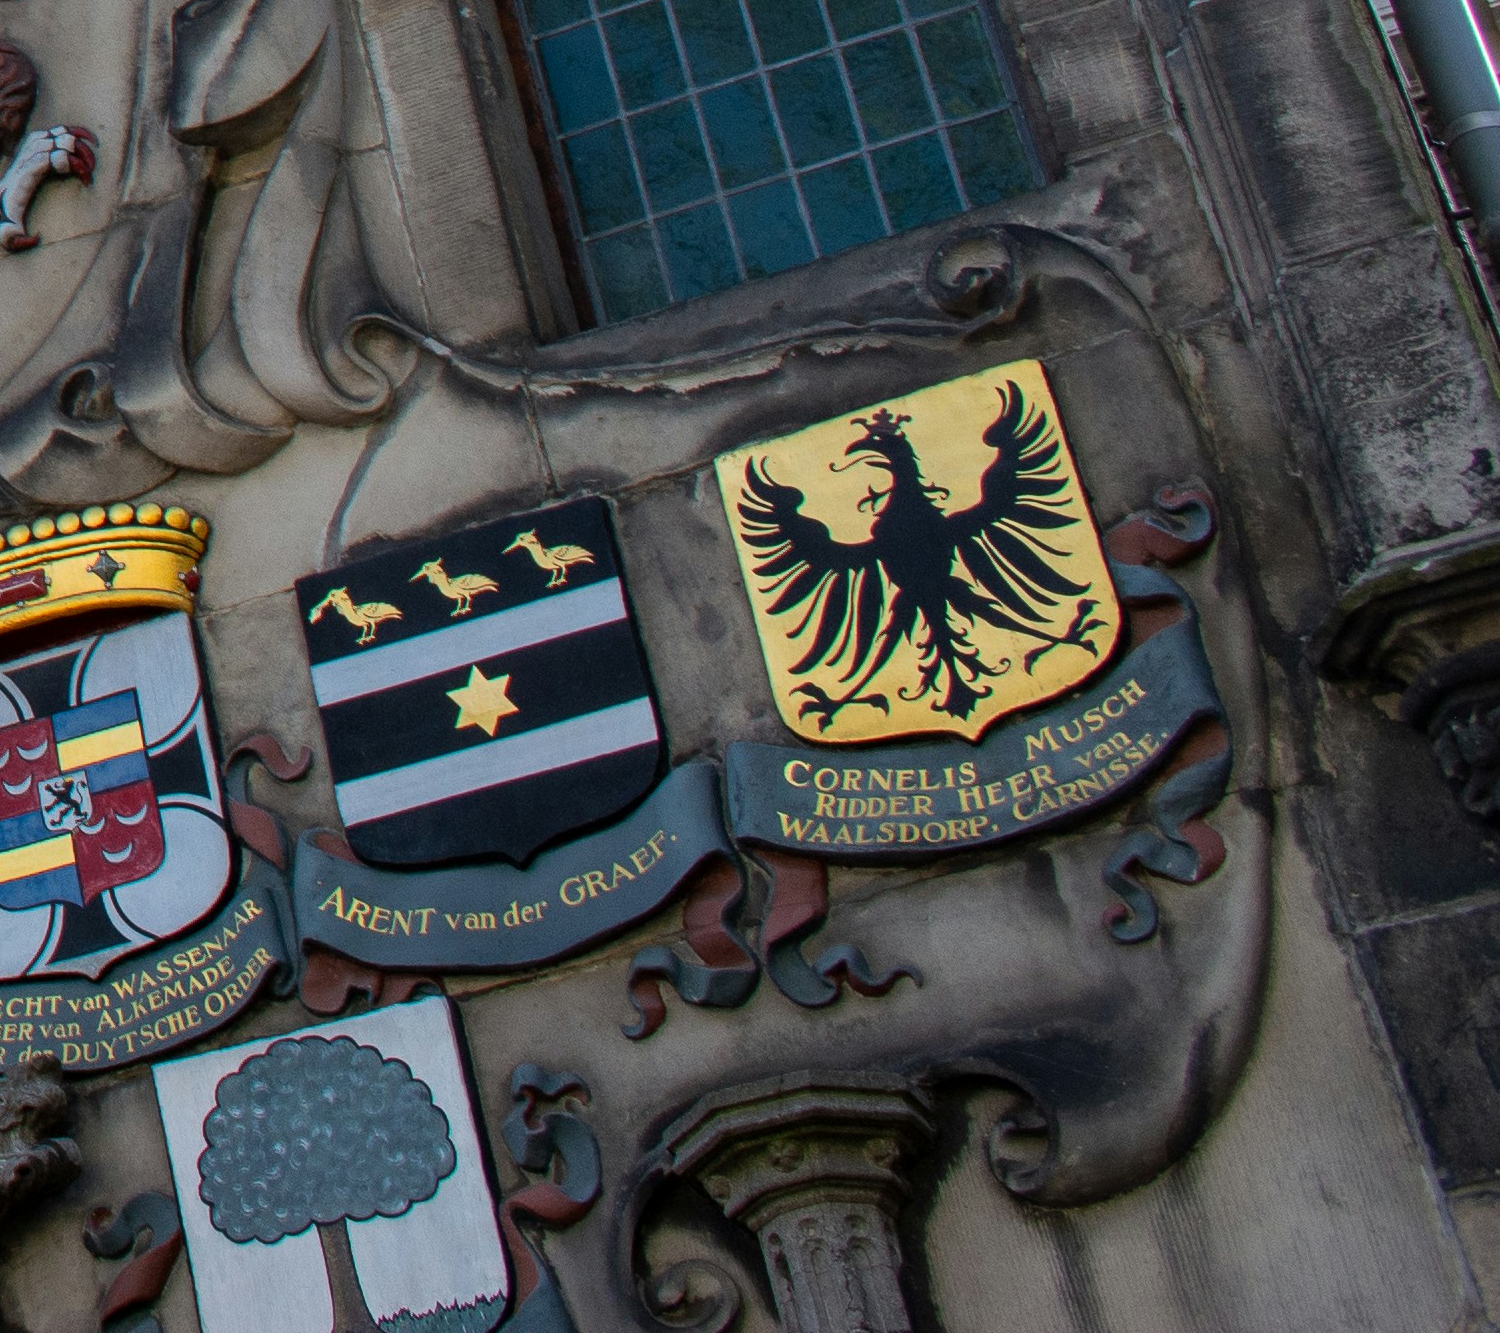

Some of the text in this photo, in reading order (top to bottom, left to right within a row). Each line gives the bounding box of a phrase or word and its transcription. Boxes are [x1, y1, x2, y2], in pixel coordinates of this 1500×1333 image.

[777, 730, 1170, 846] WAALSDORP, CARNISSE.
[783, 679, 1147, 793] CORNELIS MUSCH
[814, 732, 1133, 819] RIDDER HEER van
[318, 830, 678, 937] ARENT van der GRAEF.
[39, 1022, 81, 1039] van
[96, 955, 235, 1033] ALKEMADE
[62, 1005, 201, 1065] DUYTSCHE
[204, 946, 274, 1016] ORDER
[67, 992, 110, 1014] van
[111, 898, 264, 999] WASSENAAR
